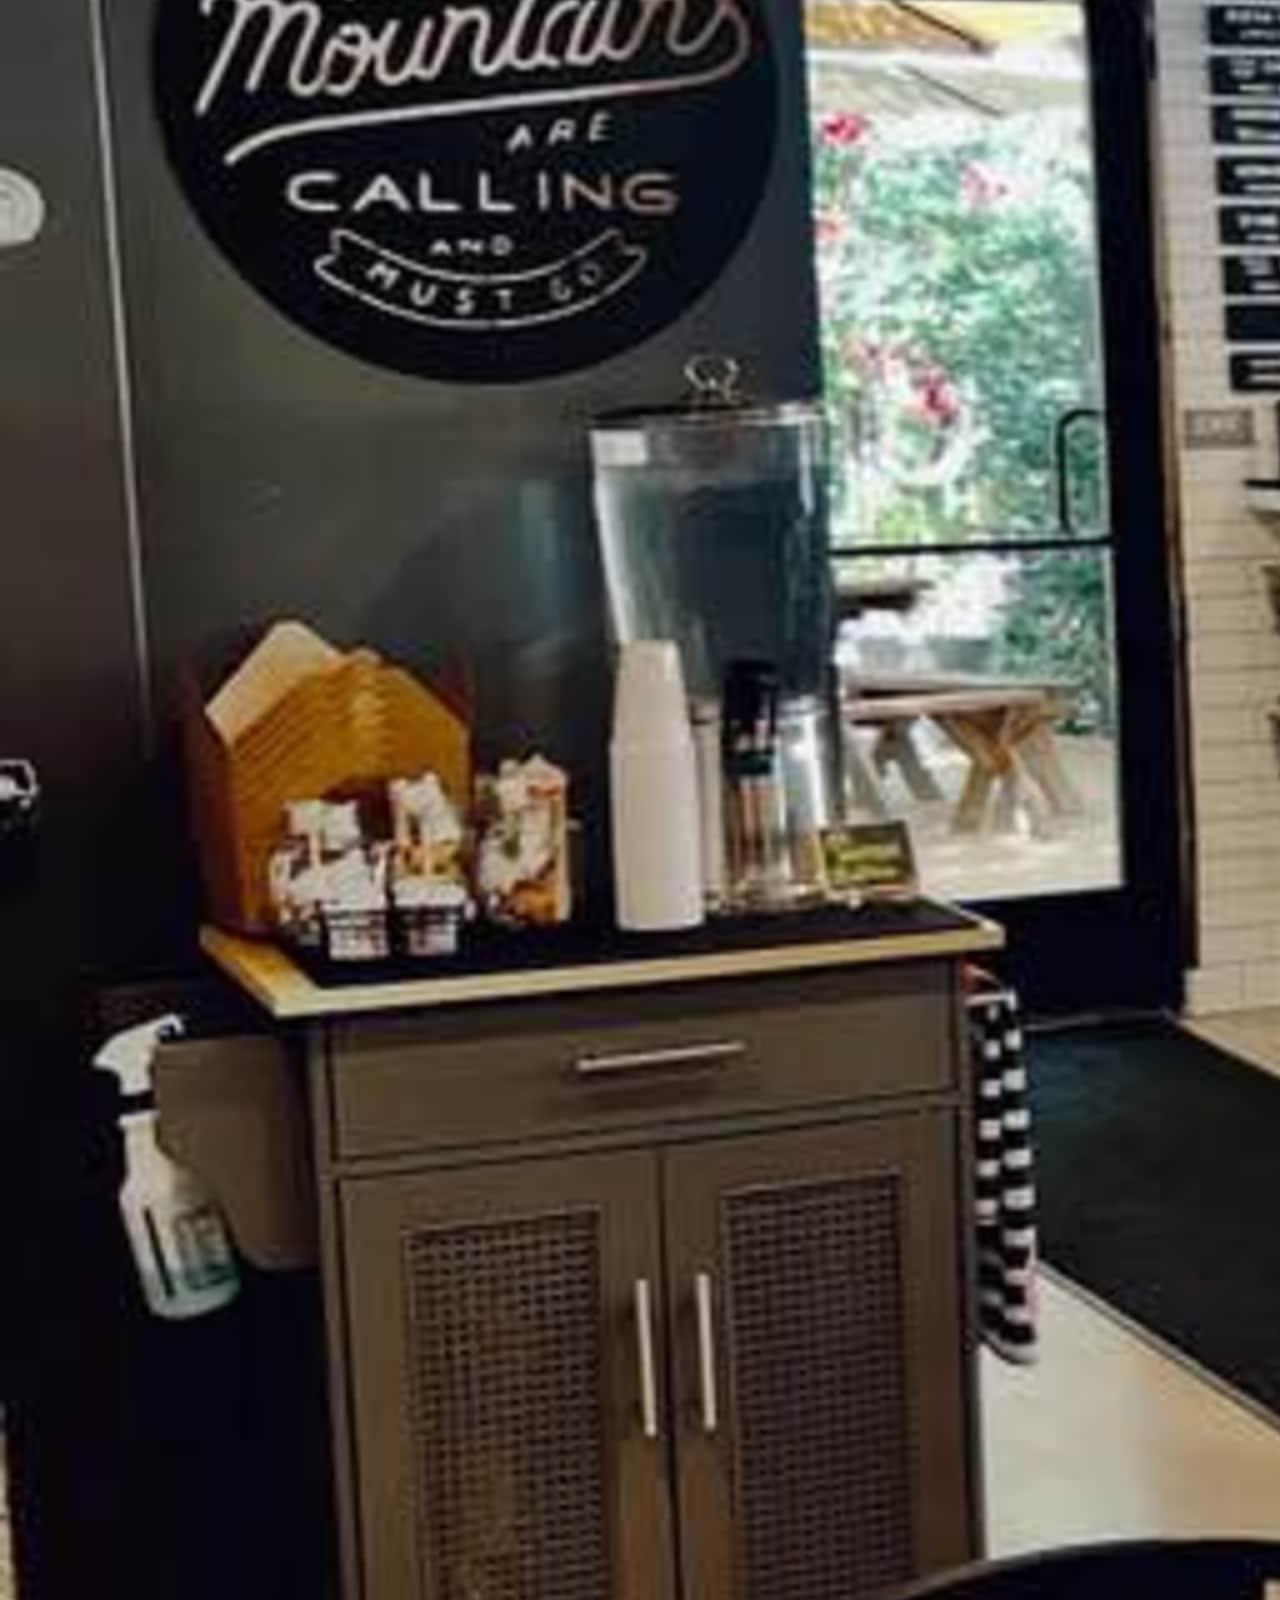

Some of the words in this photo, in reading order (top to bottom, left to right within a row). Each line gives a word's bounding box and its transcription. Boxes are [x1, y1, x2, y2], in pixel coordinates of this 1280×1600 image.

[506, 113, 612, 153] ARE
[286, 172, 679, 214] CALLING
[429, 234, 512, 257] AND
[366, 262, 514, 314] MUST
[550, 259, 602, 302] GO
